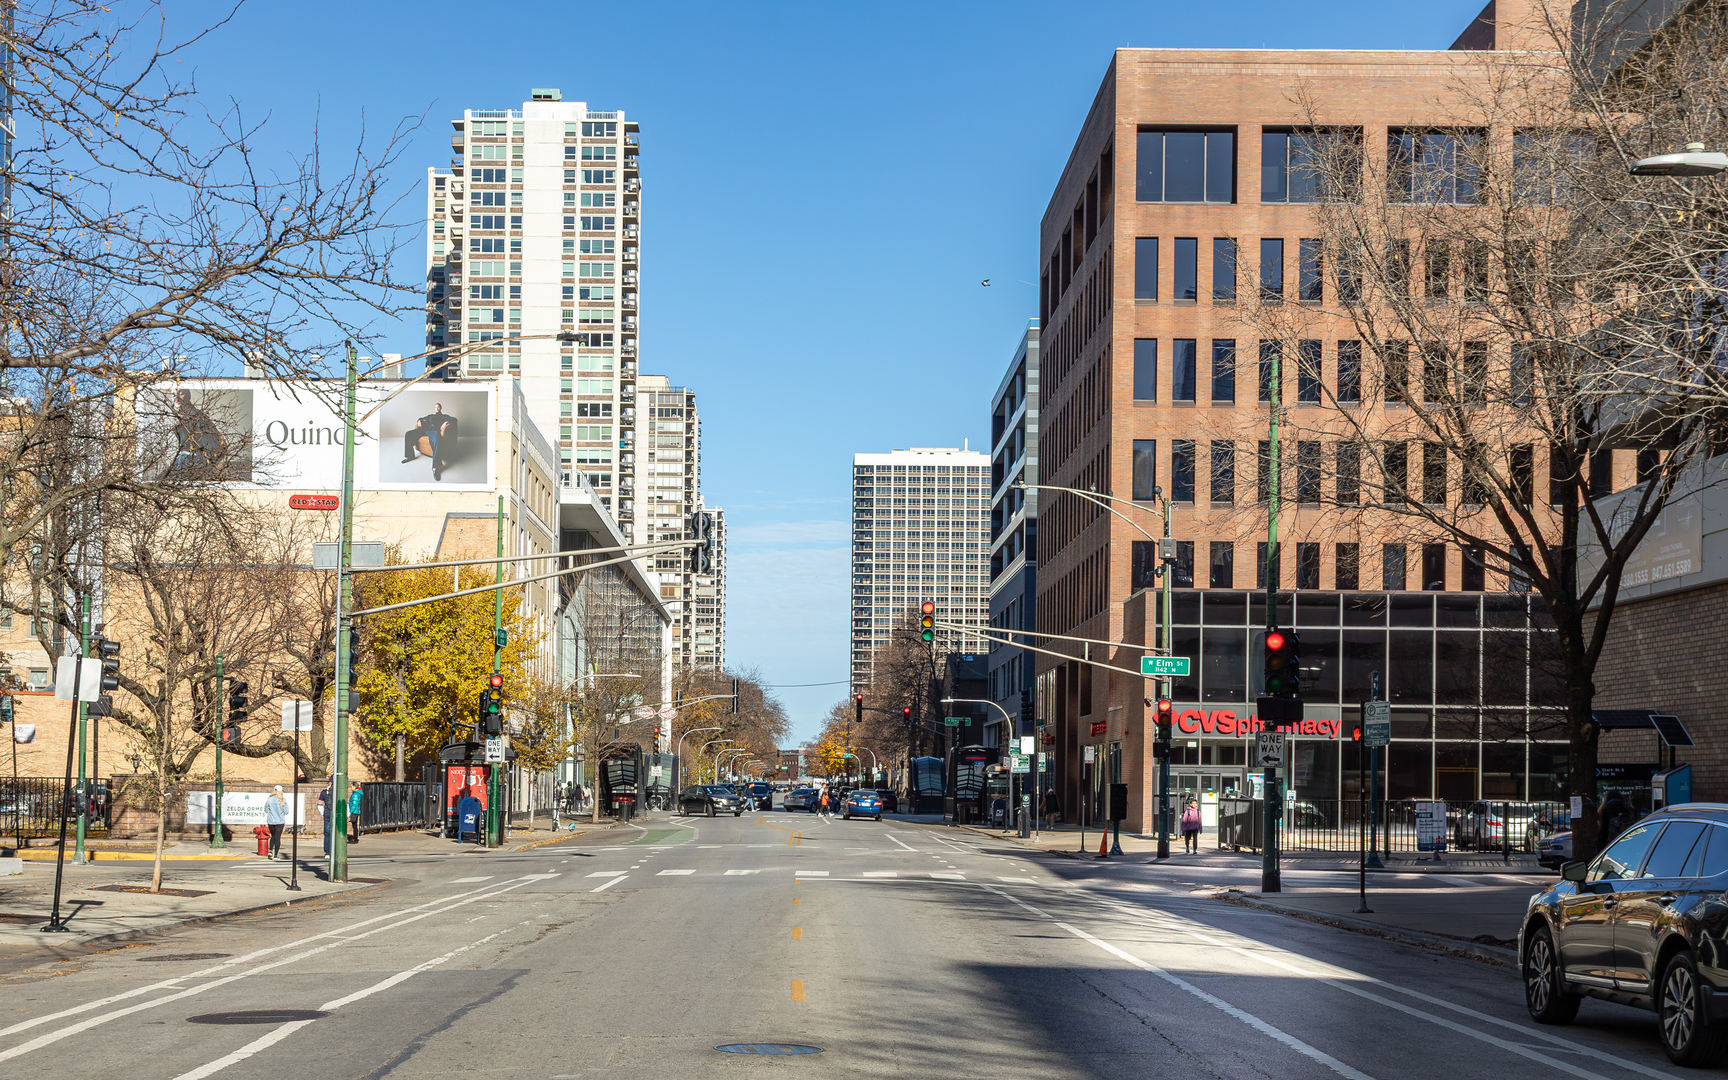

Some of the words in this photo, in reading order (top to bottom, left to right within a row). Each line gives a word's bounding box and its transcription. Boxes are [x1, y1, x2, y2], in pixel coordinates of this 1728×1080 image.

[266, 420, 365, 451] Quince
[1651, 558, 1692, 580] 847.651.5589
[1156, 659, 1173, 667] Elm
[1262, 734, 1282, 744] ONE
[1260, 744, 1282, 754] WAY
